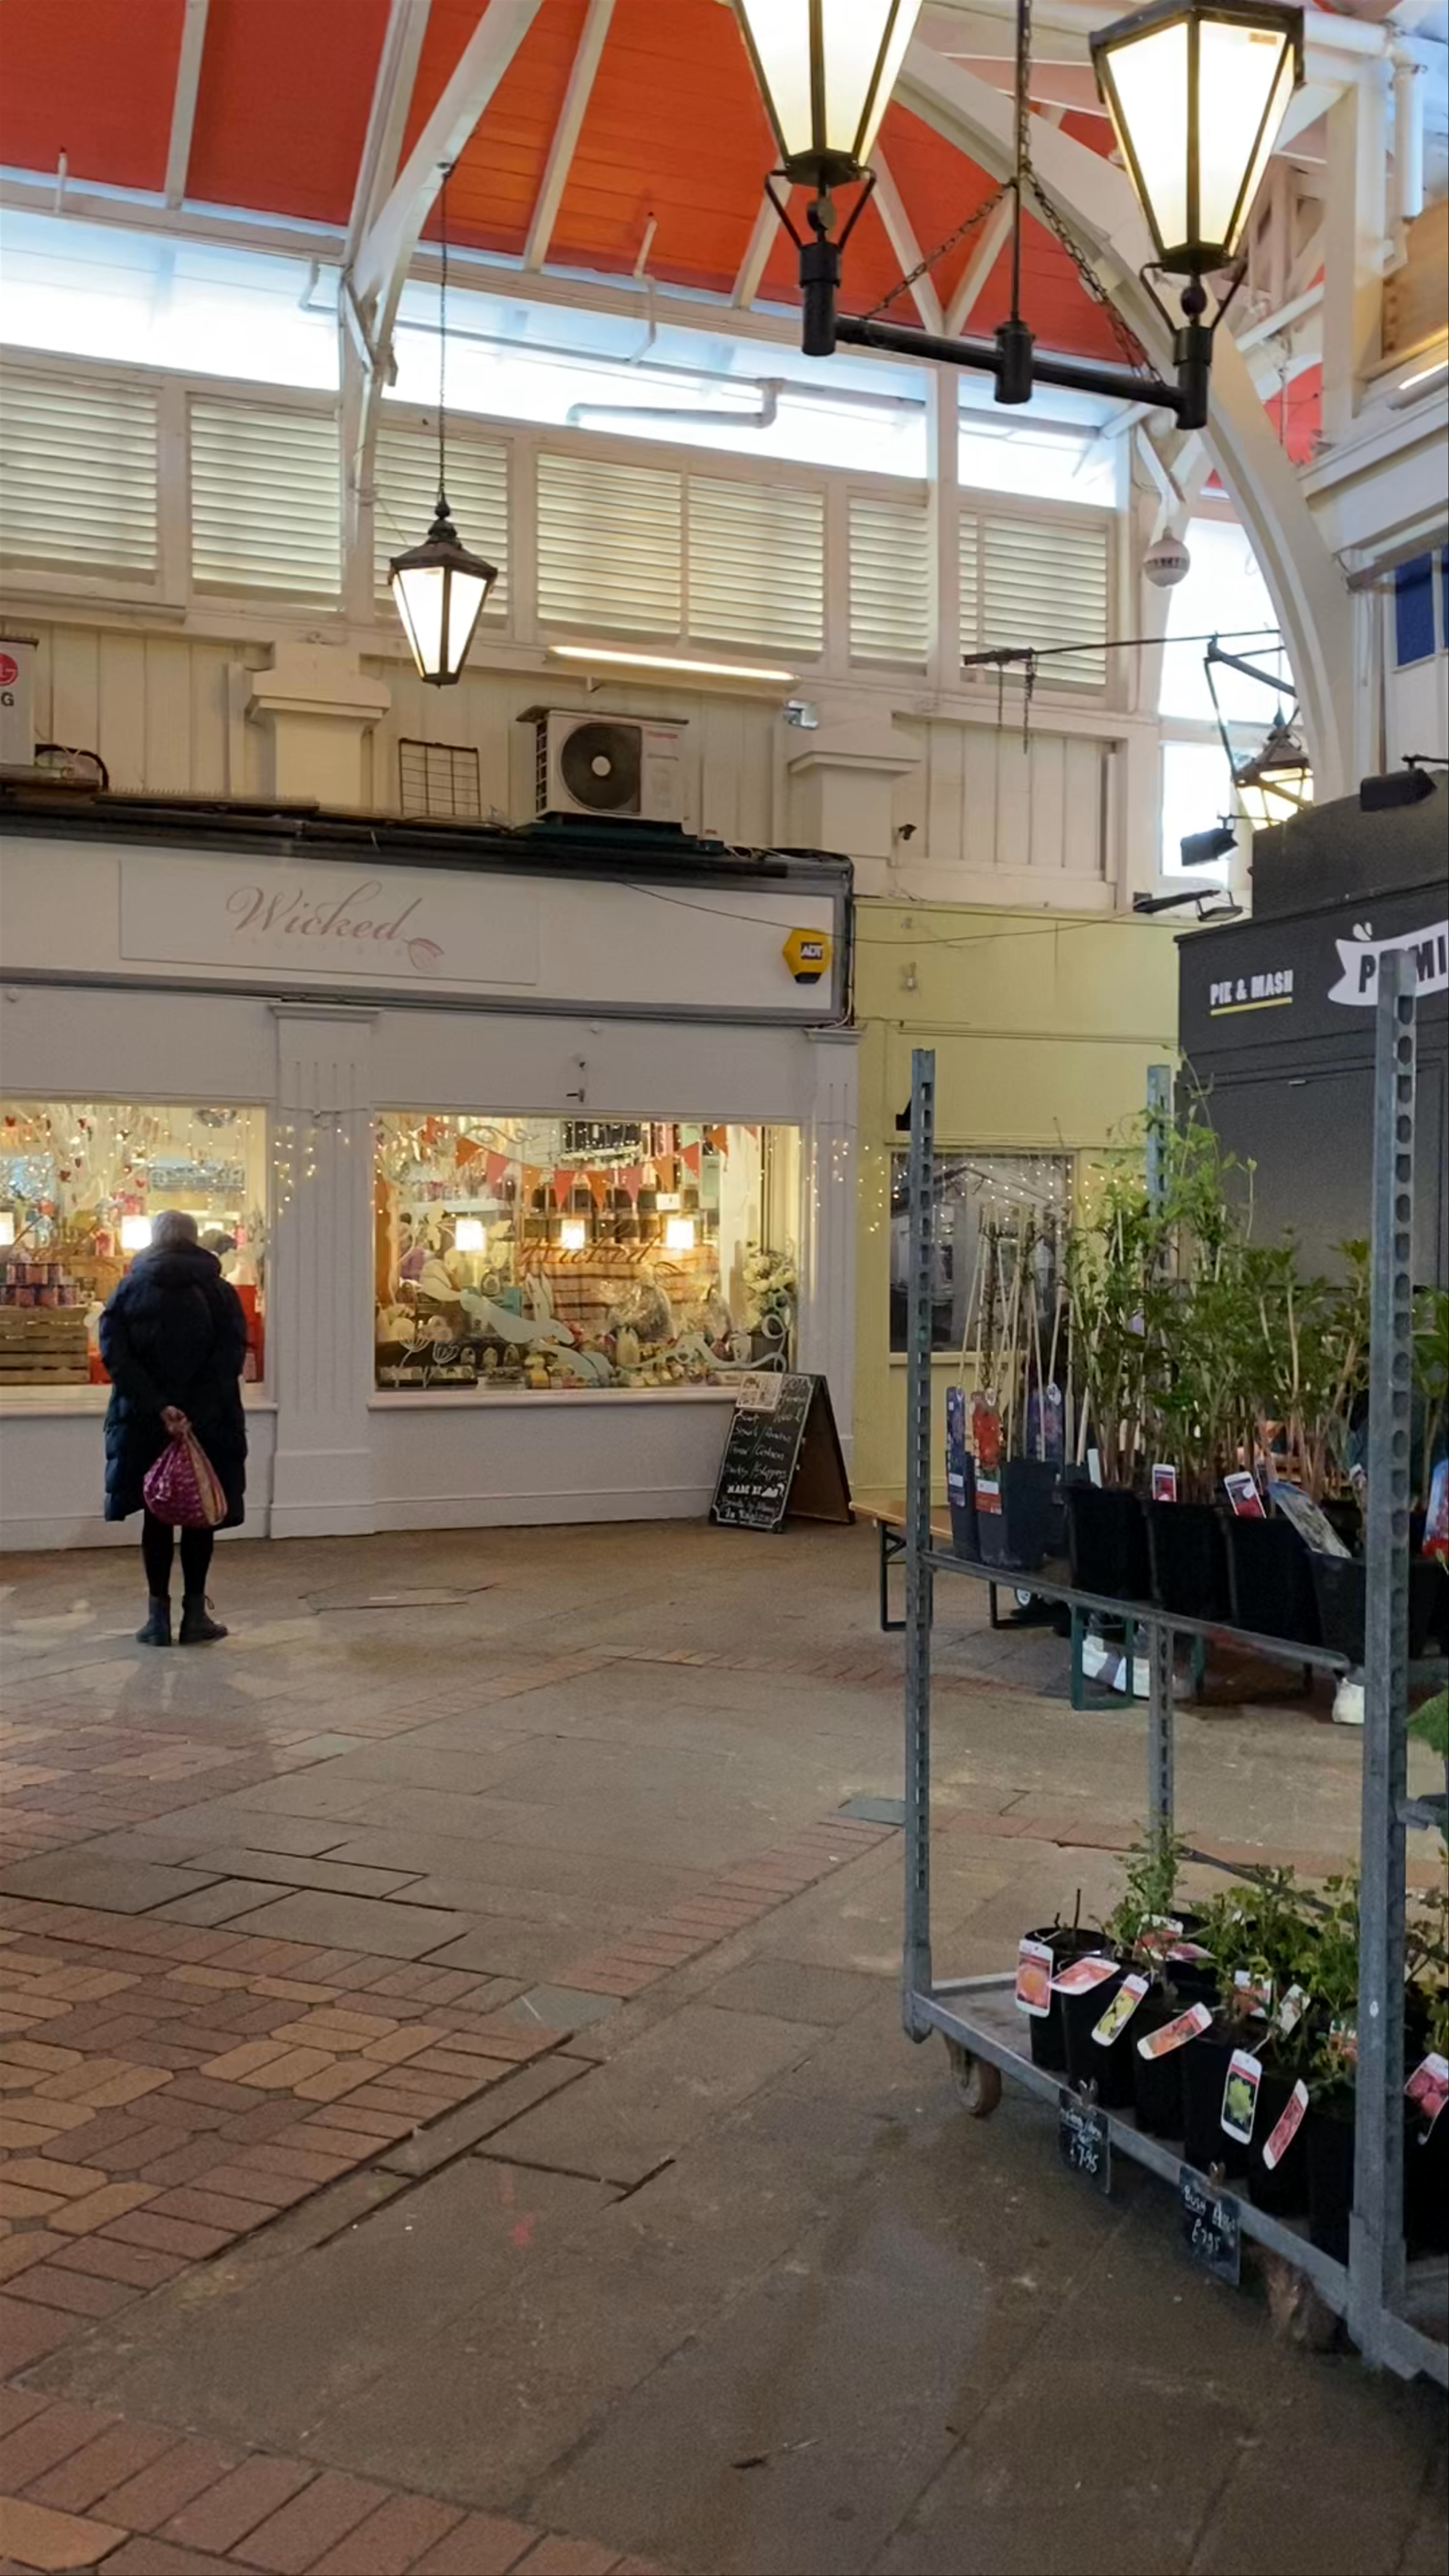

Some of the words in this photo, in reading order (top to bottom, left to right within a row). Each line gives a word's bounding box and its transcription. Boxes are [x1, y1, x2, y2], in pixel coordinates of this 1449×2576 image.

[226, 880, 423, 940] Wicked
[1210, 981, 1232, 1006] PIE
[1236, 978, 1247, 1001] &
[1251, 969, 1294, 998] MASH
[1358, 935, 1446, 993] PMI
